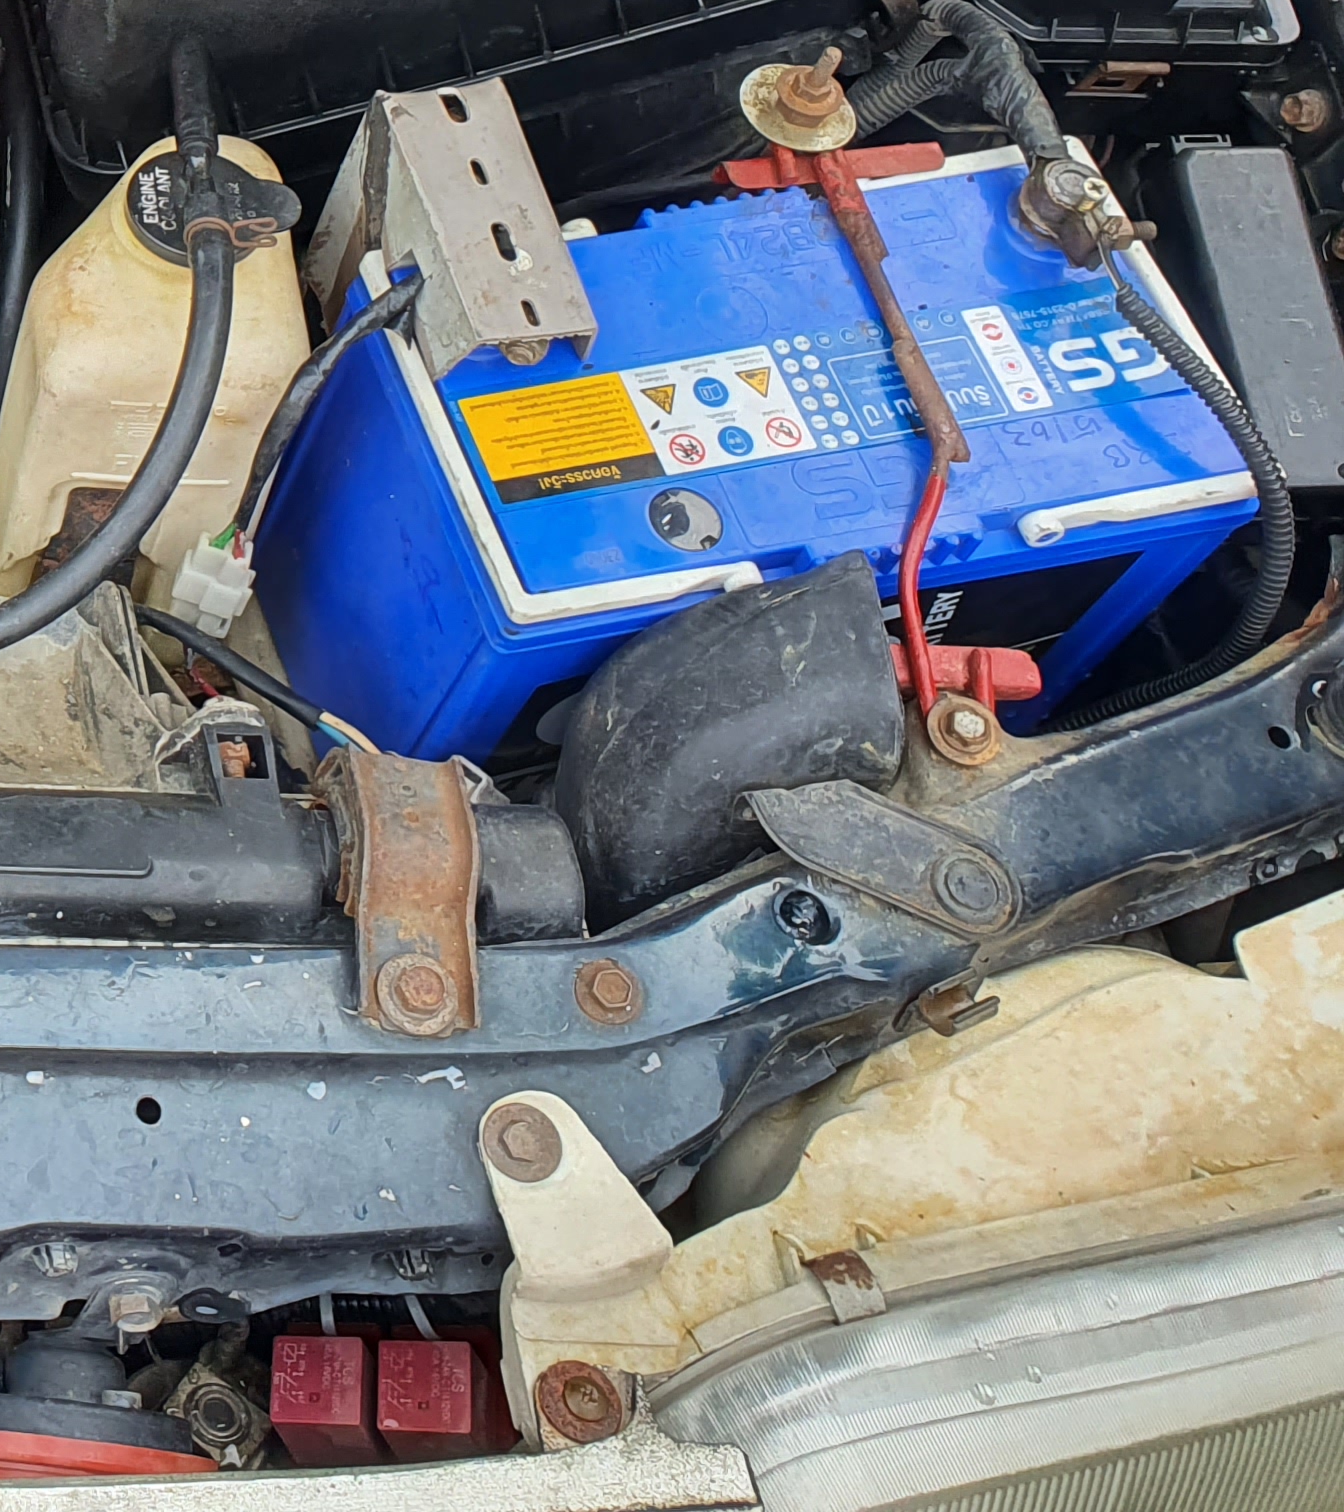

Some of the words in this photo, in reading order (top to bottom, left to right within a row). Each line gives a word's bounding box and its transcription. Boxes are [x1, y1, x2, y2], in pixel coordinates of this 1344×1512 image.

[138, 172, 159, 224] ENGINE
[1029, 345, 1065, 394] BATTERY
[1048, 326, 1171, 392] GS
